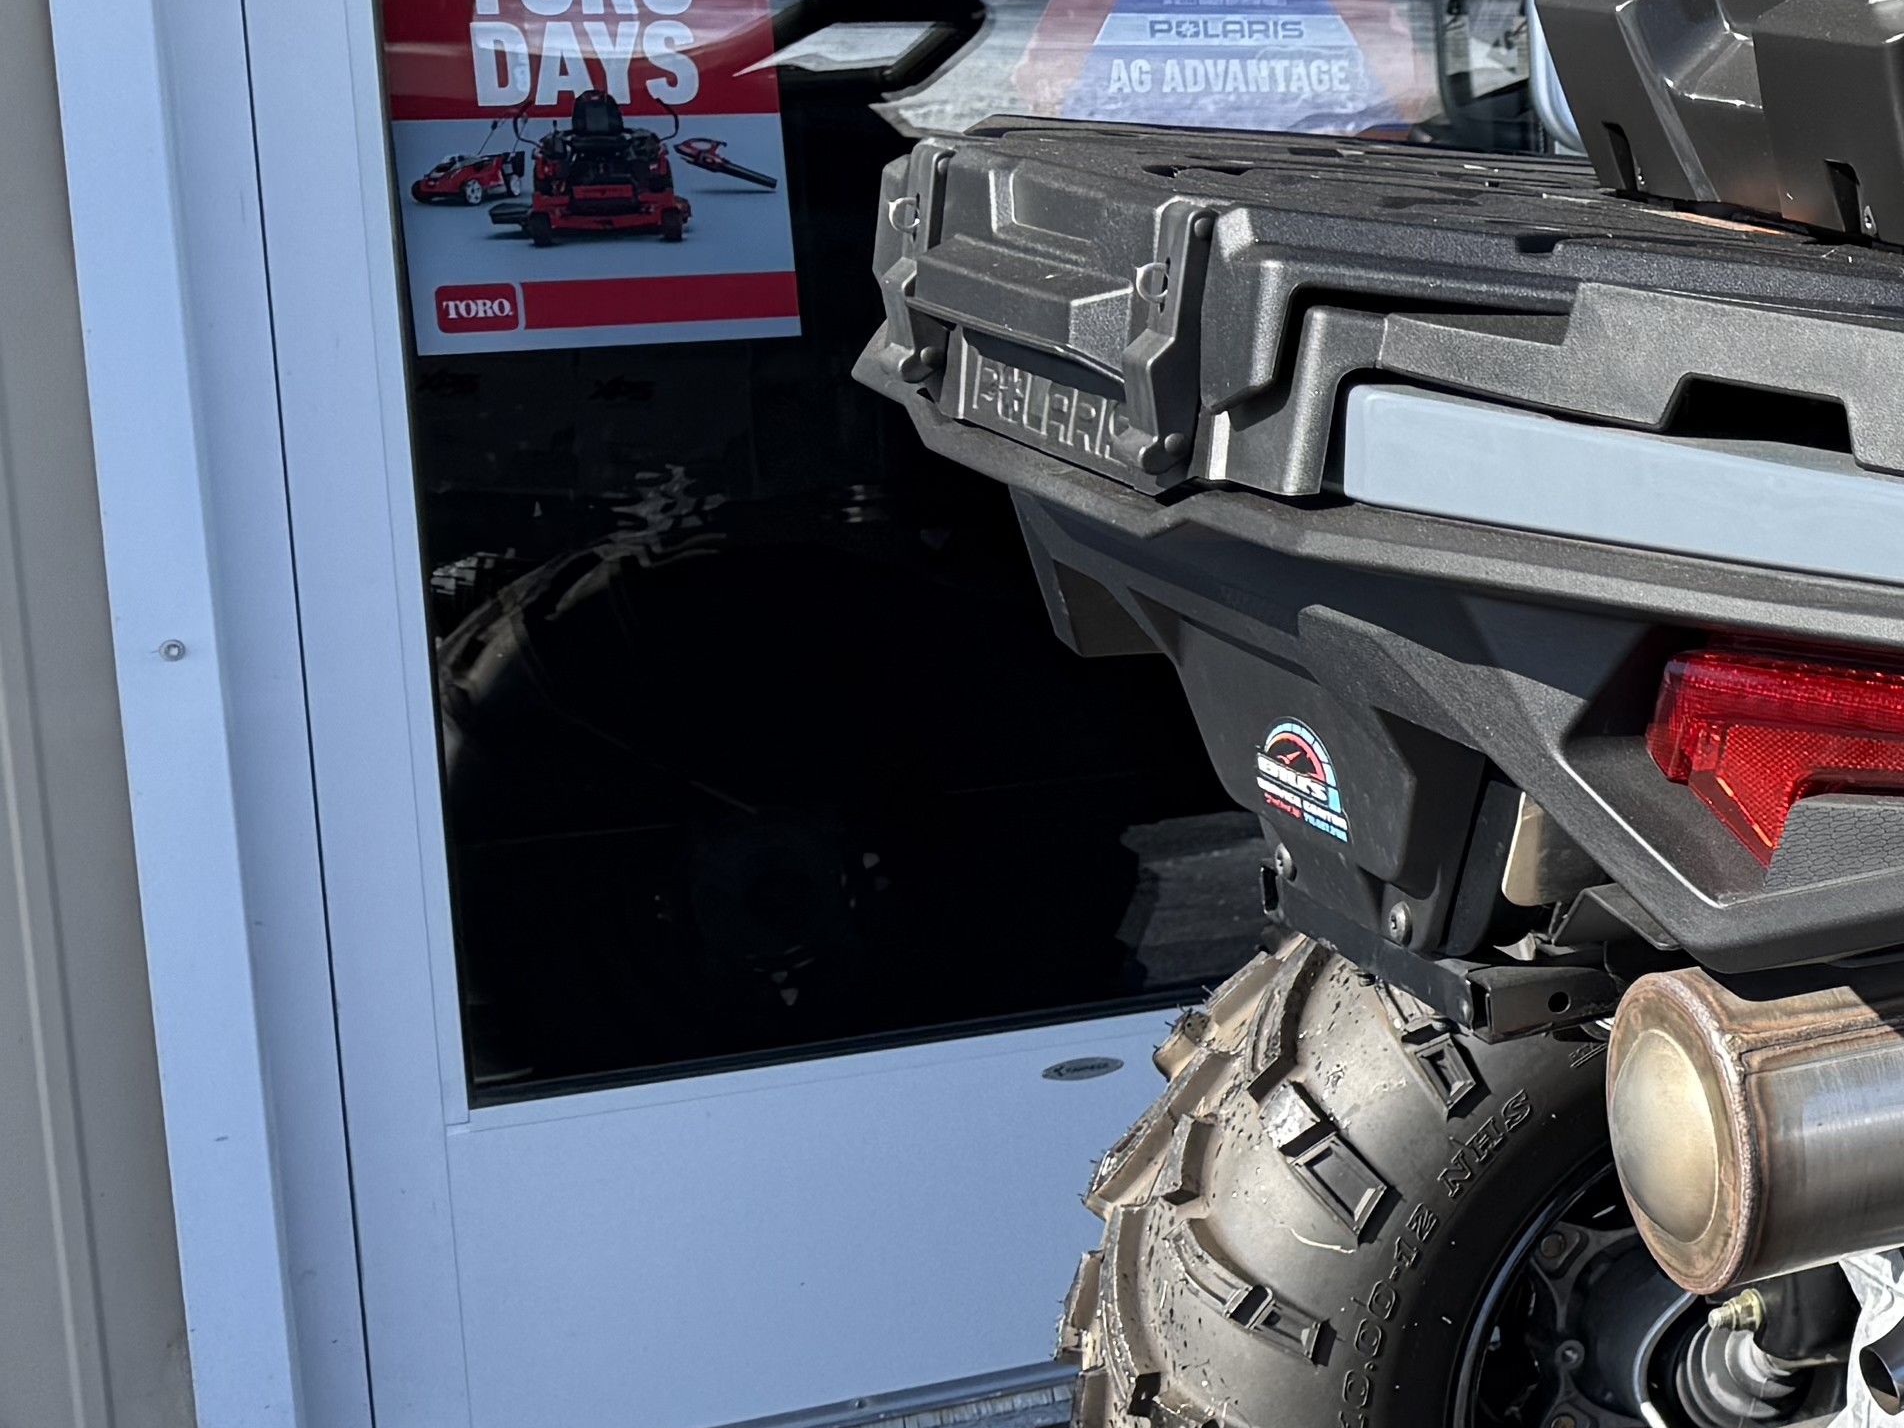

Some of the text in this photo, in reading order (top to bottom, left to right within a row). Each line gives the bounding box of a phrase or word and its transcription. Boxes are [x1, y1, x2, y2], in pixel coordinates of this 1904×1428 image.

[1149, 19, 1305, 40] POLARIS
[469, 20, 701, 107] DAYS
[1108, 59, 1351, 94] AG ADVANTAGE
[443, 298, 511, 320] TORO
[1437, 1087, 1534, 1199] NHS
